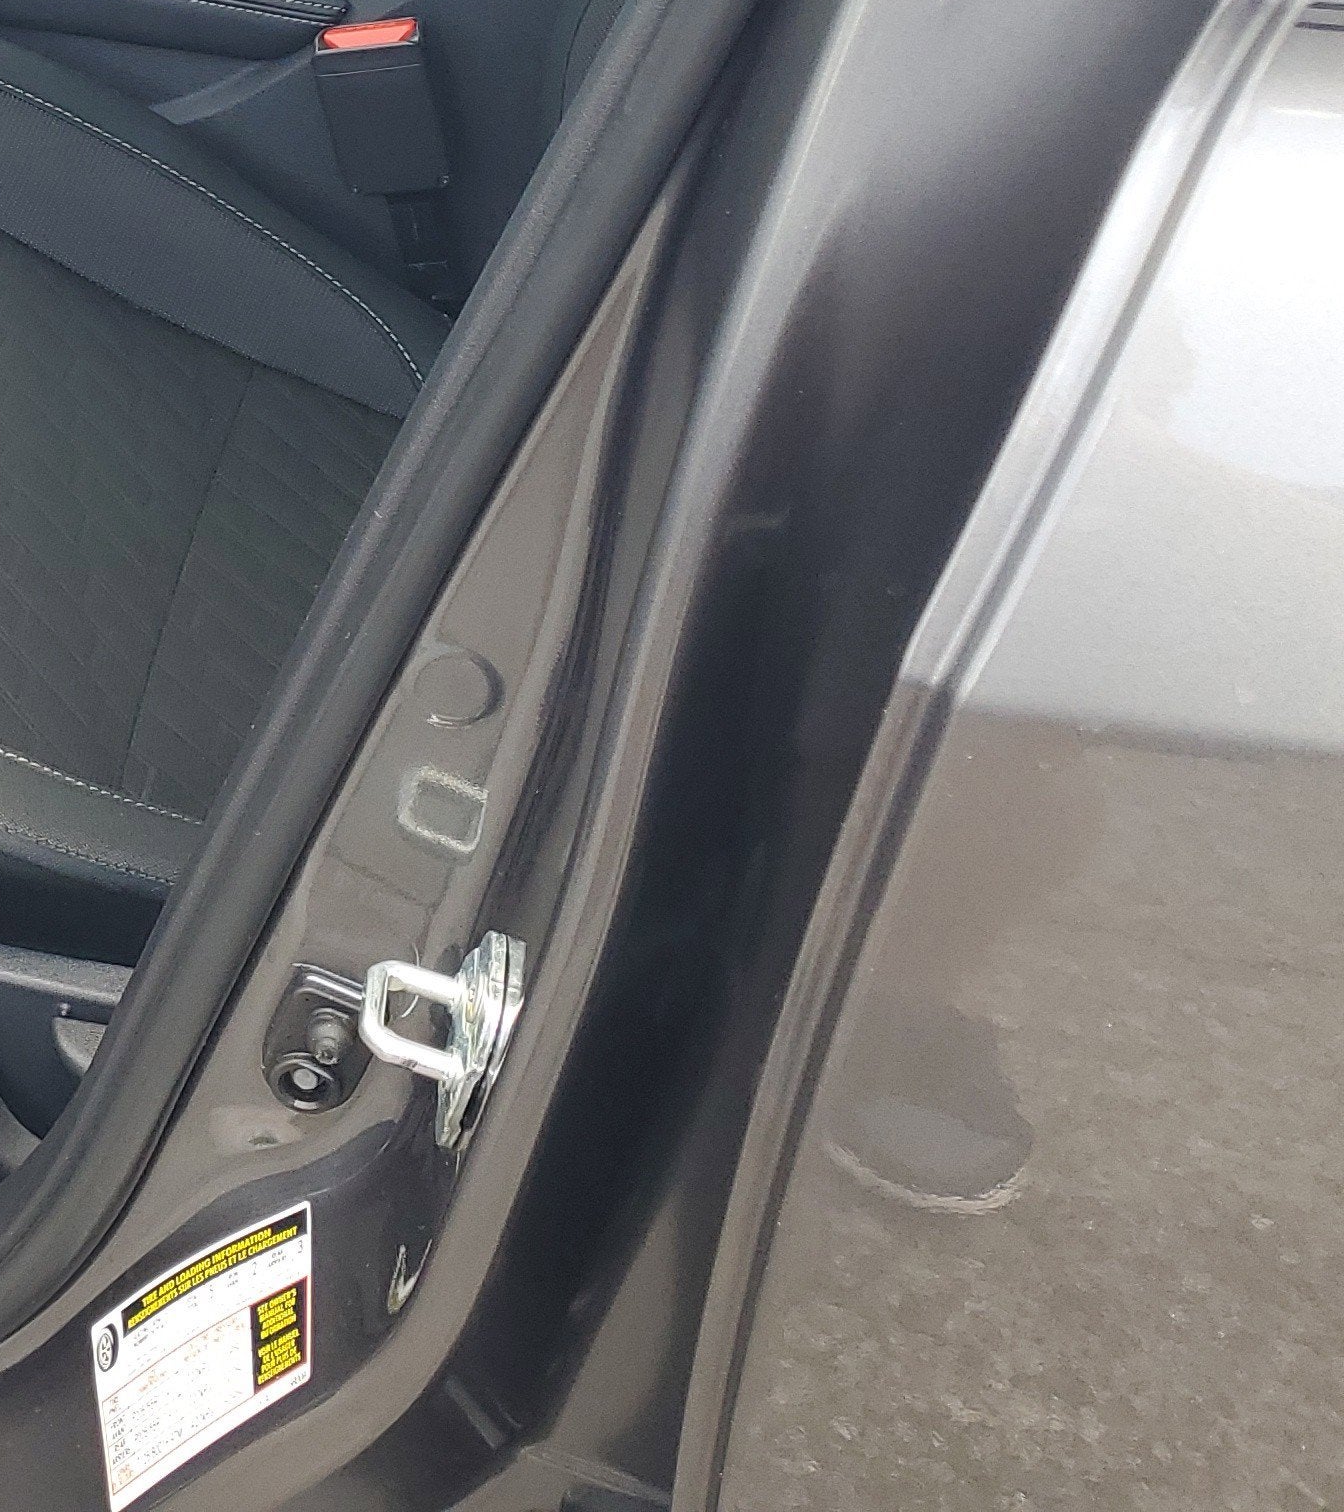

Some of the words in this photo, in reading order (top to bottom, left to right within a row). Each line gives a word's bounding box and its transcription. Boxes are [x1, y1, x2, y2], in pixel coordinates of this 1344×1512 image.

[141, 1289, 159, 1308] TIRE
[158, 1279, 175, 1297] AND
[175, 1257, 211, 1285] LOADING
[211, 1227, 272, 1264] INFORMATION
[178, 1279, 192, 1295] SUR
[191, 1272, 205, 1287] LES
[204, 1259, 228, 1279] PNEUS
[247, 1225, 298, 1256] CHARGEMENT
